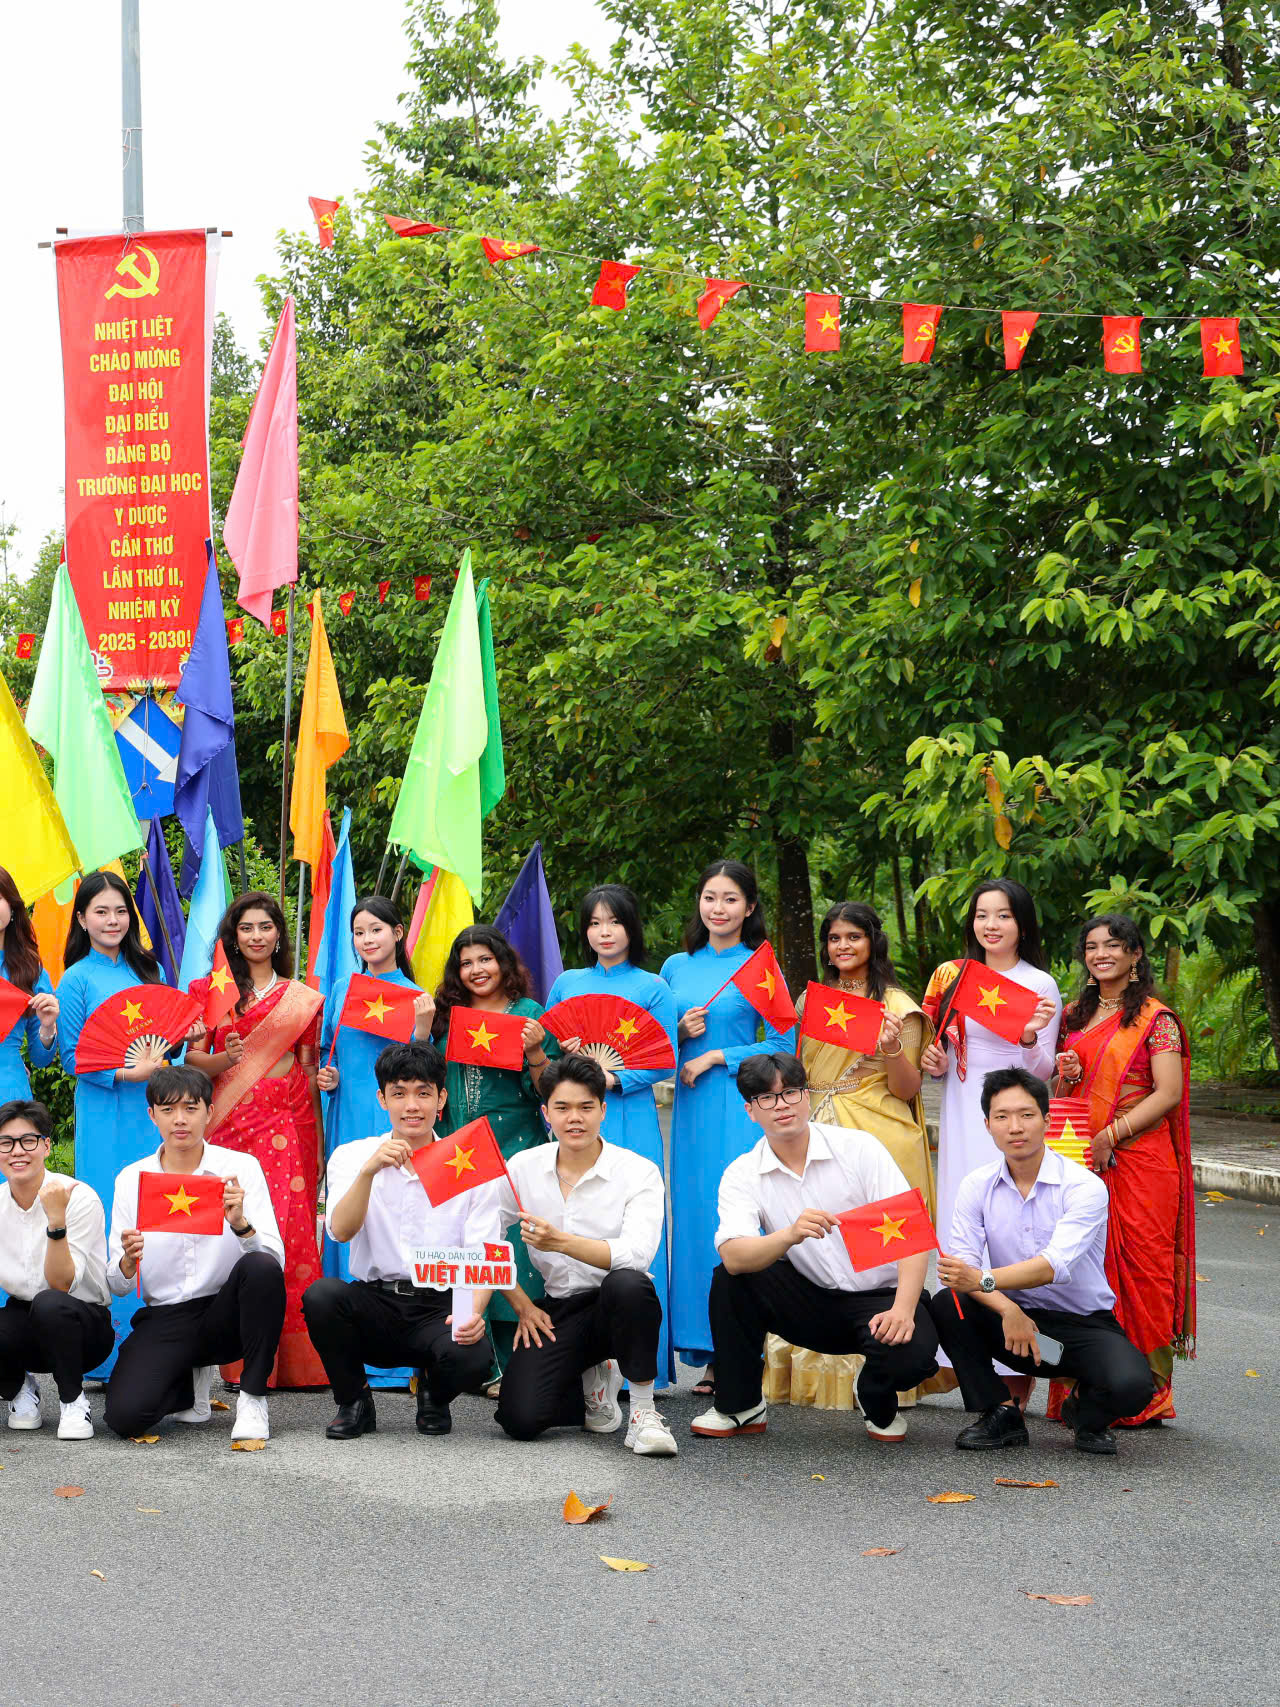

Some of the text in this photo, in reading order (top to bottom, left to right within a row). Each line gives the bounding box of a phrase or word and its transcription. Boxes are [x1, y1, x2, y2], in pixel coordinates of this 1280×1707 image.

[95, 314, 173, 343] NHIỆT LIỆT
[89, 346, 181, 372] CHÀO MỪNG
[108, 377, 163, 405] ĐẠI HỘI
[105, 405, 169, 437] ĐẠI BIỂU
[105, 439, 171, 465] ĐẢNG BỘ
[76, 473, 202, 497] TRƯỜNG ĐẠI HỌC
[114, 504, 167, 528] Y DƯỢC
[110, 532, 174, 558] CẦN THƠ
[103, 564, 184, 589] LẦN THỨ II,
[108, 595, 180, 623] NHIỆM KỲ
[98, 632, 136, 652] 2025
[149, 629, 192, 650] 2030!
[414, 1260, 512, 1286] VIỆT NAM
